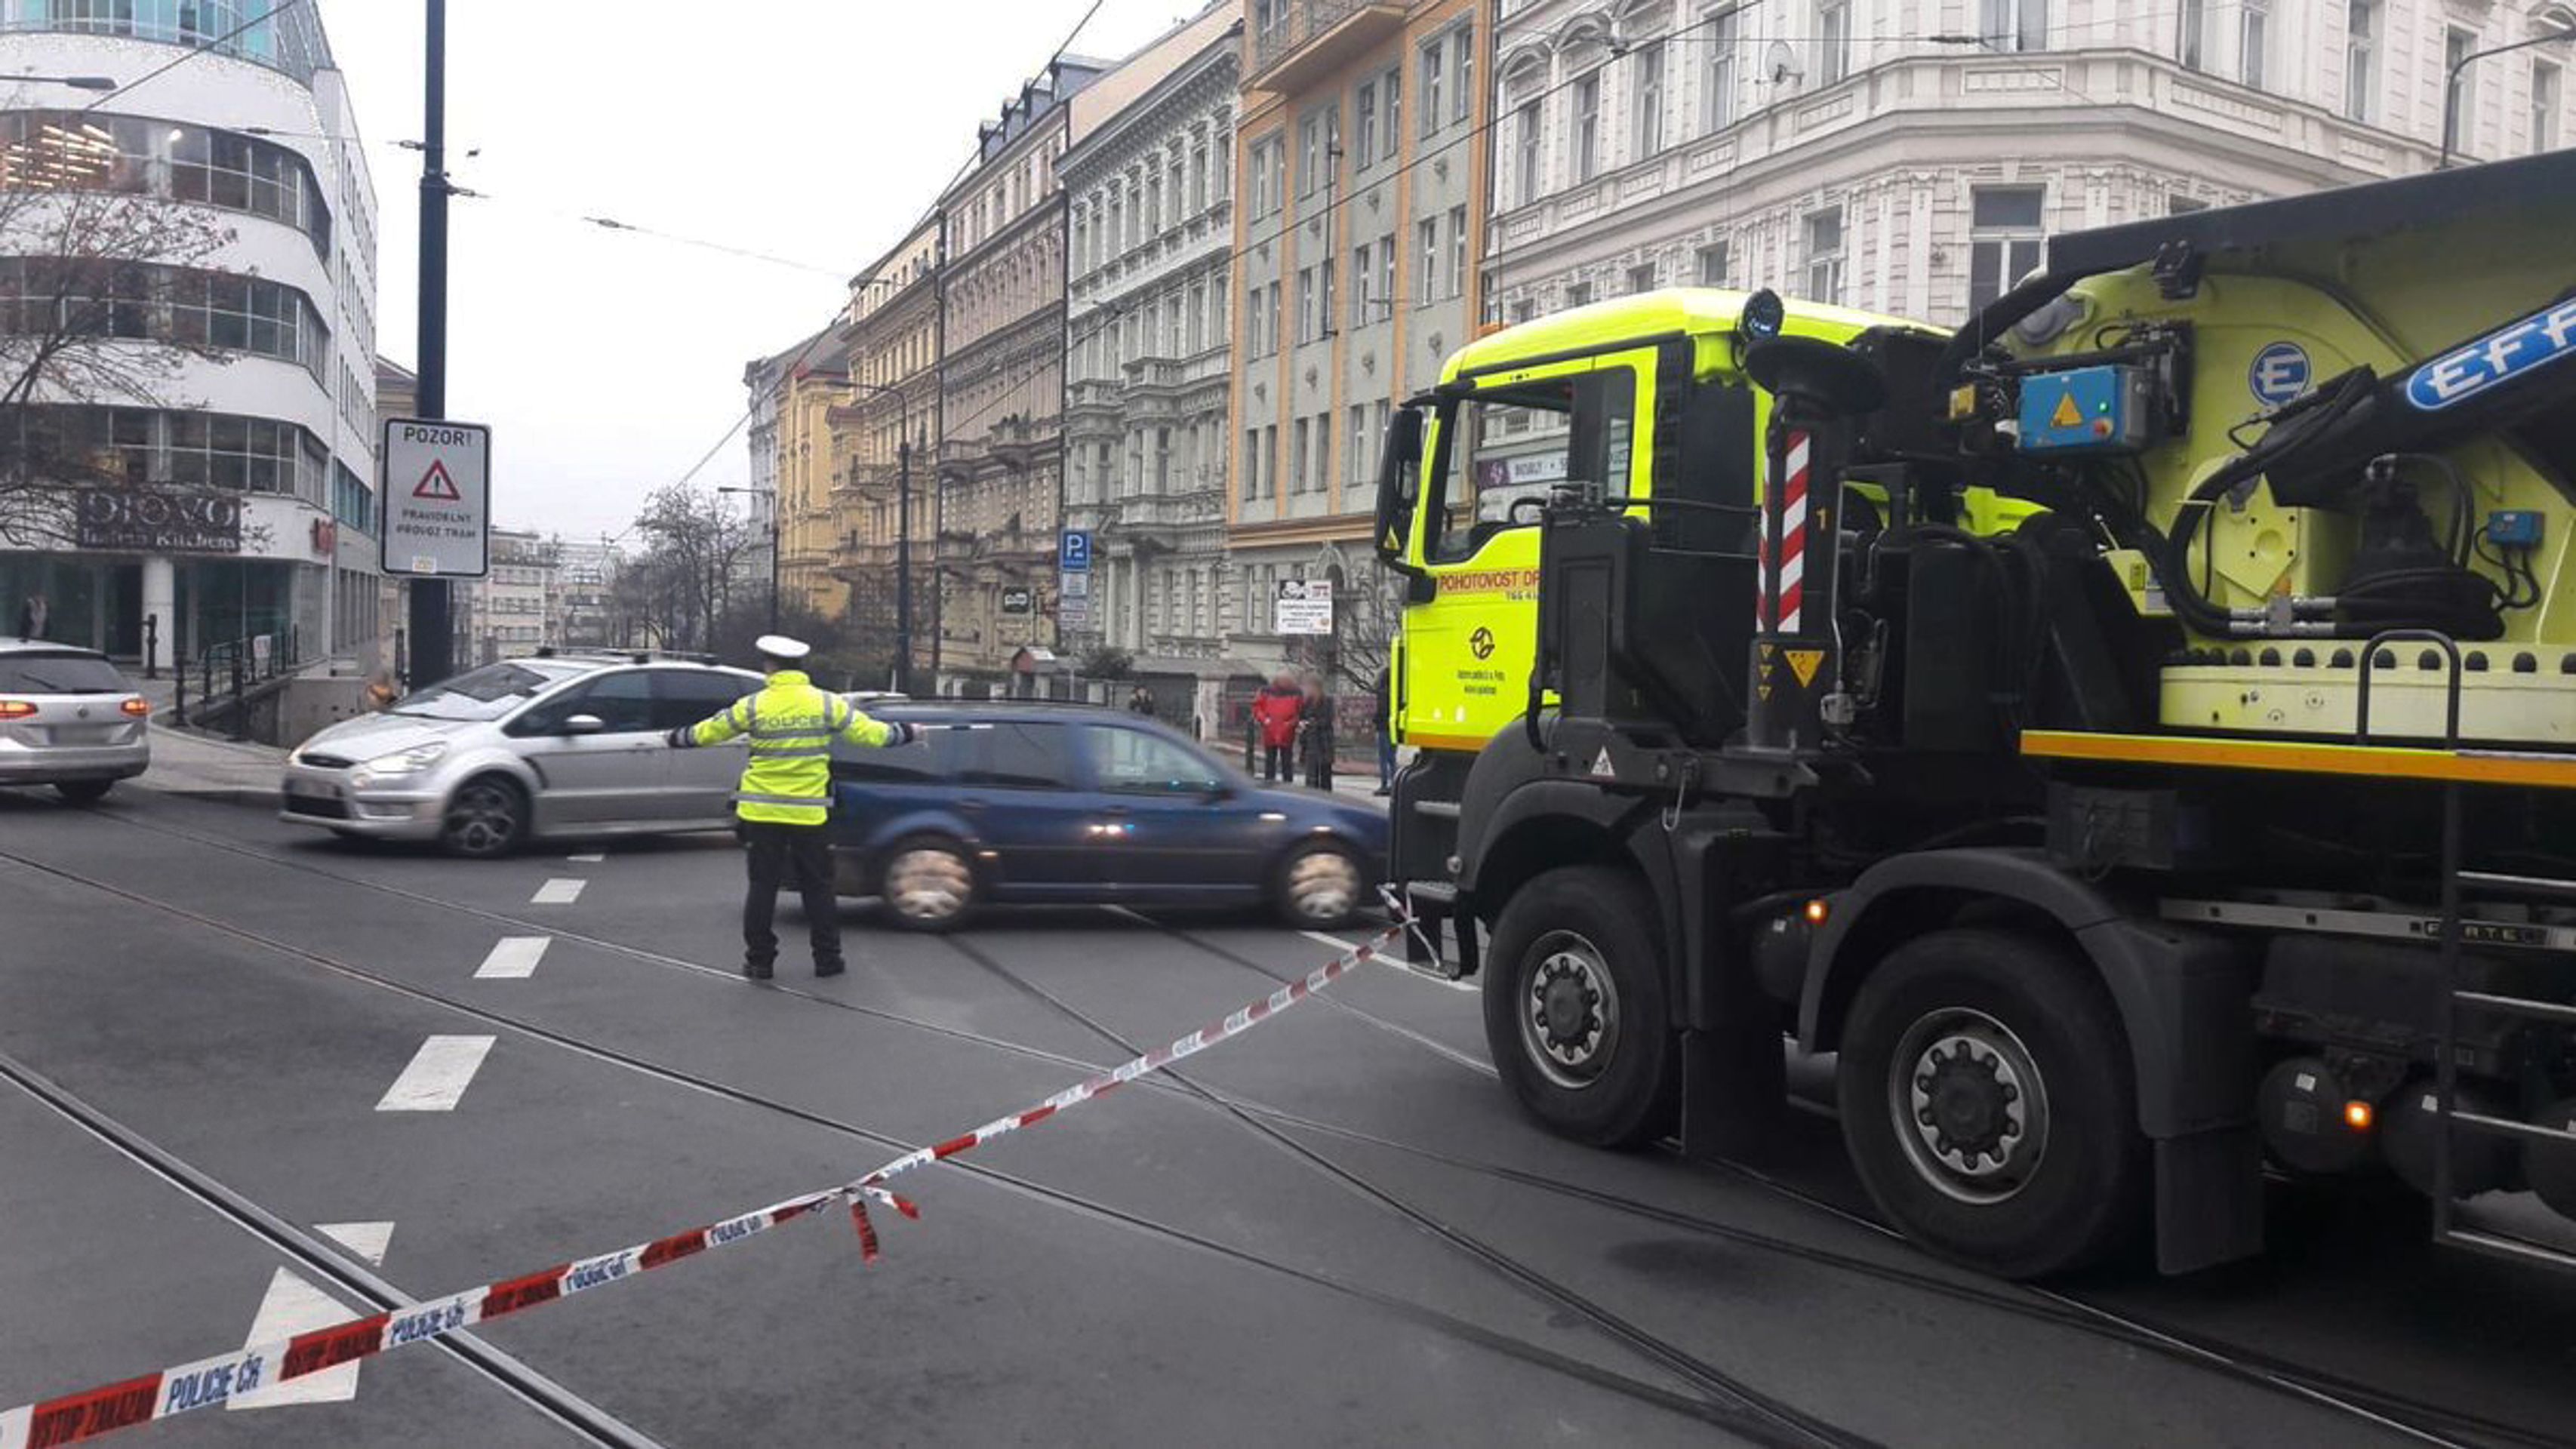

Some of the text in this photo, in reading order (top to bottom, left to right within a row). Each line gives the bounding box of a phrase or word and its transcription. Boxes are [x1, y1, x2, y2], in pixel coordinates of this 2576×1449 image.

[404, 426, 472, 448] POZOR!
[396, 525, 475, 538] PROVOZ TRAM
[1441, 571, 1517, 590] POHOTOVOST
[756, 715, 825, 731] POLICE
[165, 1363, 238, 1413] POLICIE
